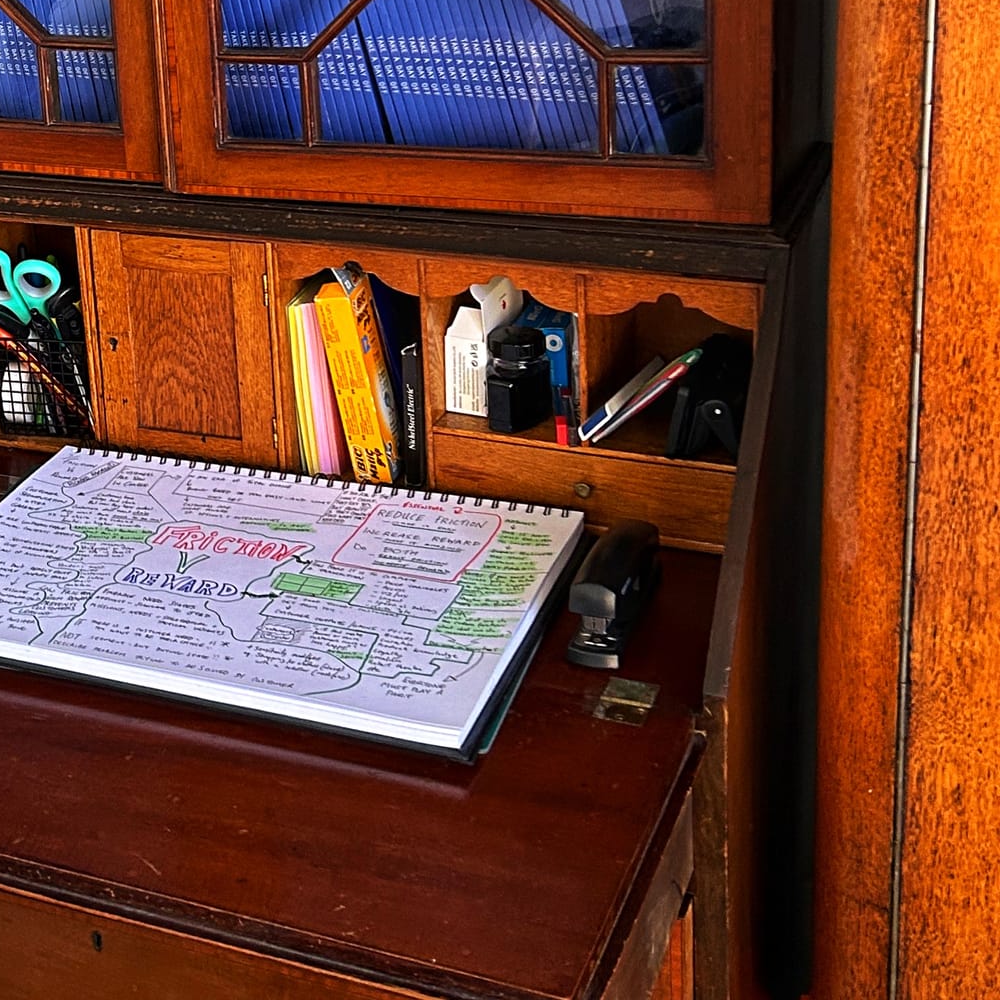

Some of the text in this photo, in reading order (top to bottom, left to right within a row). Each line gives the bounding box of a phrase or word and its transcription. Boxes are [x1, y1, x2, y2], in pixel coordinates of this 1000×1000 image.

[365, 35, 376, 52] TAKE
[374, 65, 383, 77] DAY
[376, 35, 387, 52] TAKE
[384, 65, 394, 77] DAY
[398, 36, 408, 53] TAKE
[406, 65, 415, 78] DAY
[516, 40, 528, 58] TAKE
[525, 71, 535, 84] DAY
[540, 41, 550, 59] TAKE
[548, 72, 558, 85] DAY
[377, 509, 489, 529] REDUCE FRICTION
[153, 525, 308, 562] FRICTION
[362, 527, 481, 546] INCREASE REWARD
[383, 547, 419, 555] BOTH
[177, 551, 210, 575] V
[123, 567, 238, 597] REWARD
[60, 631, 81, 640] NOT
